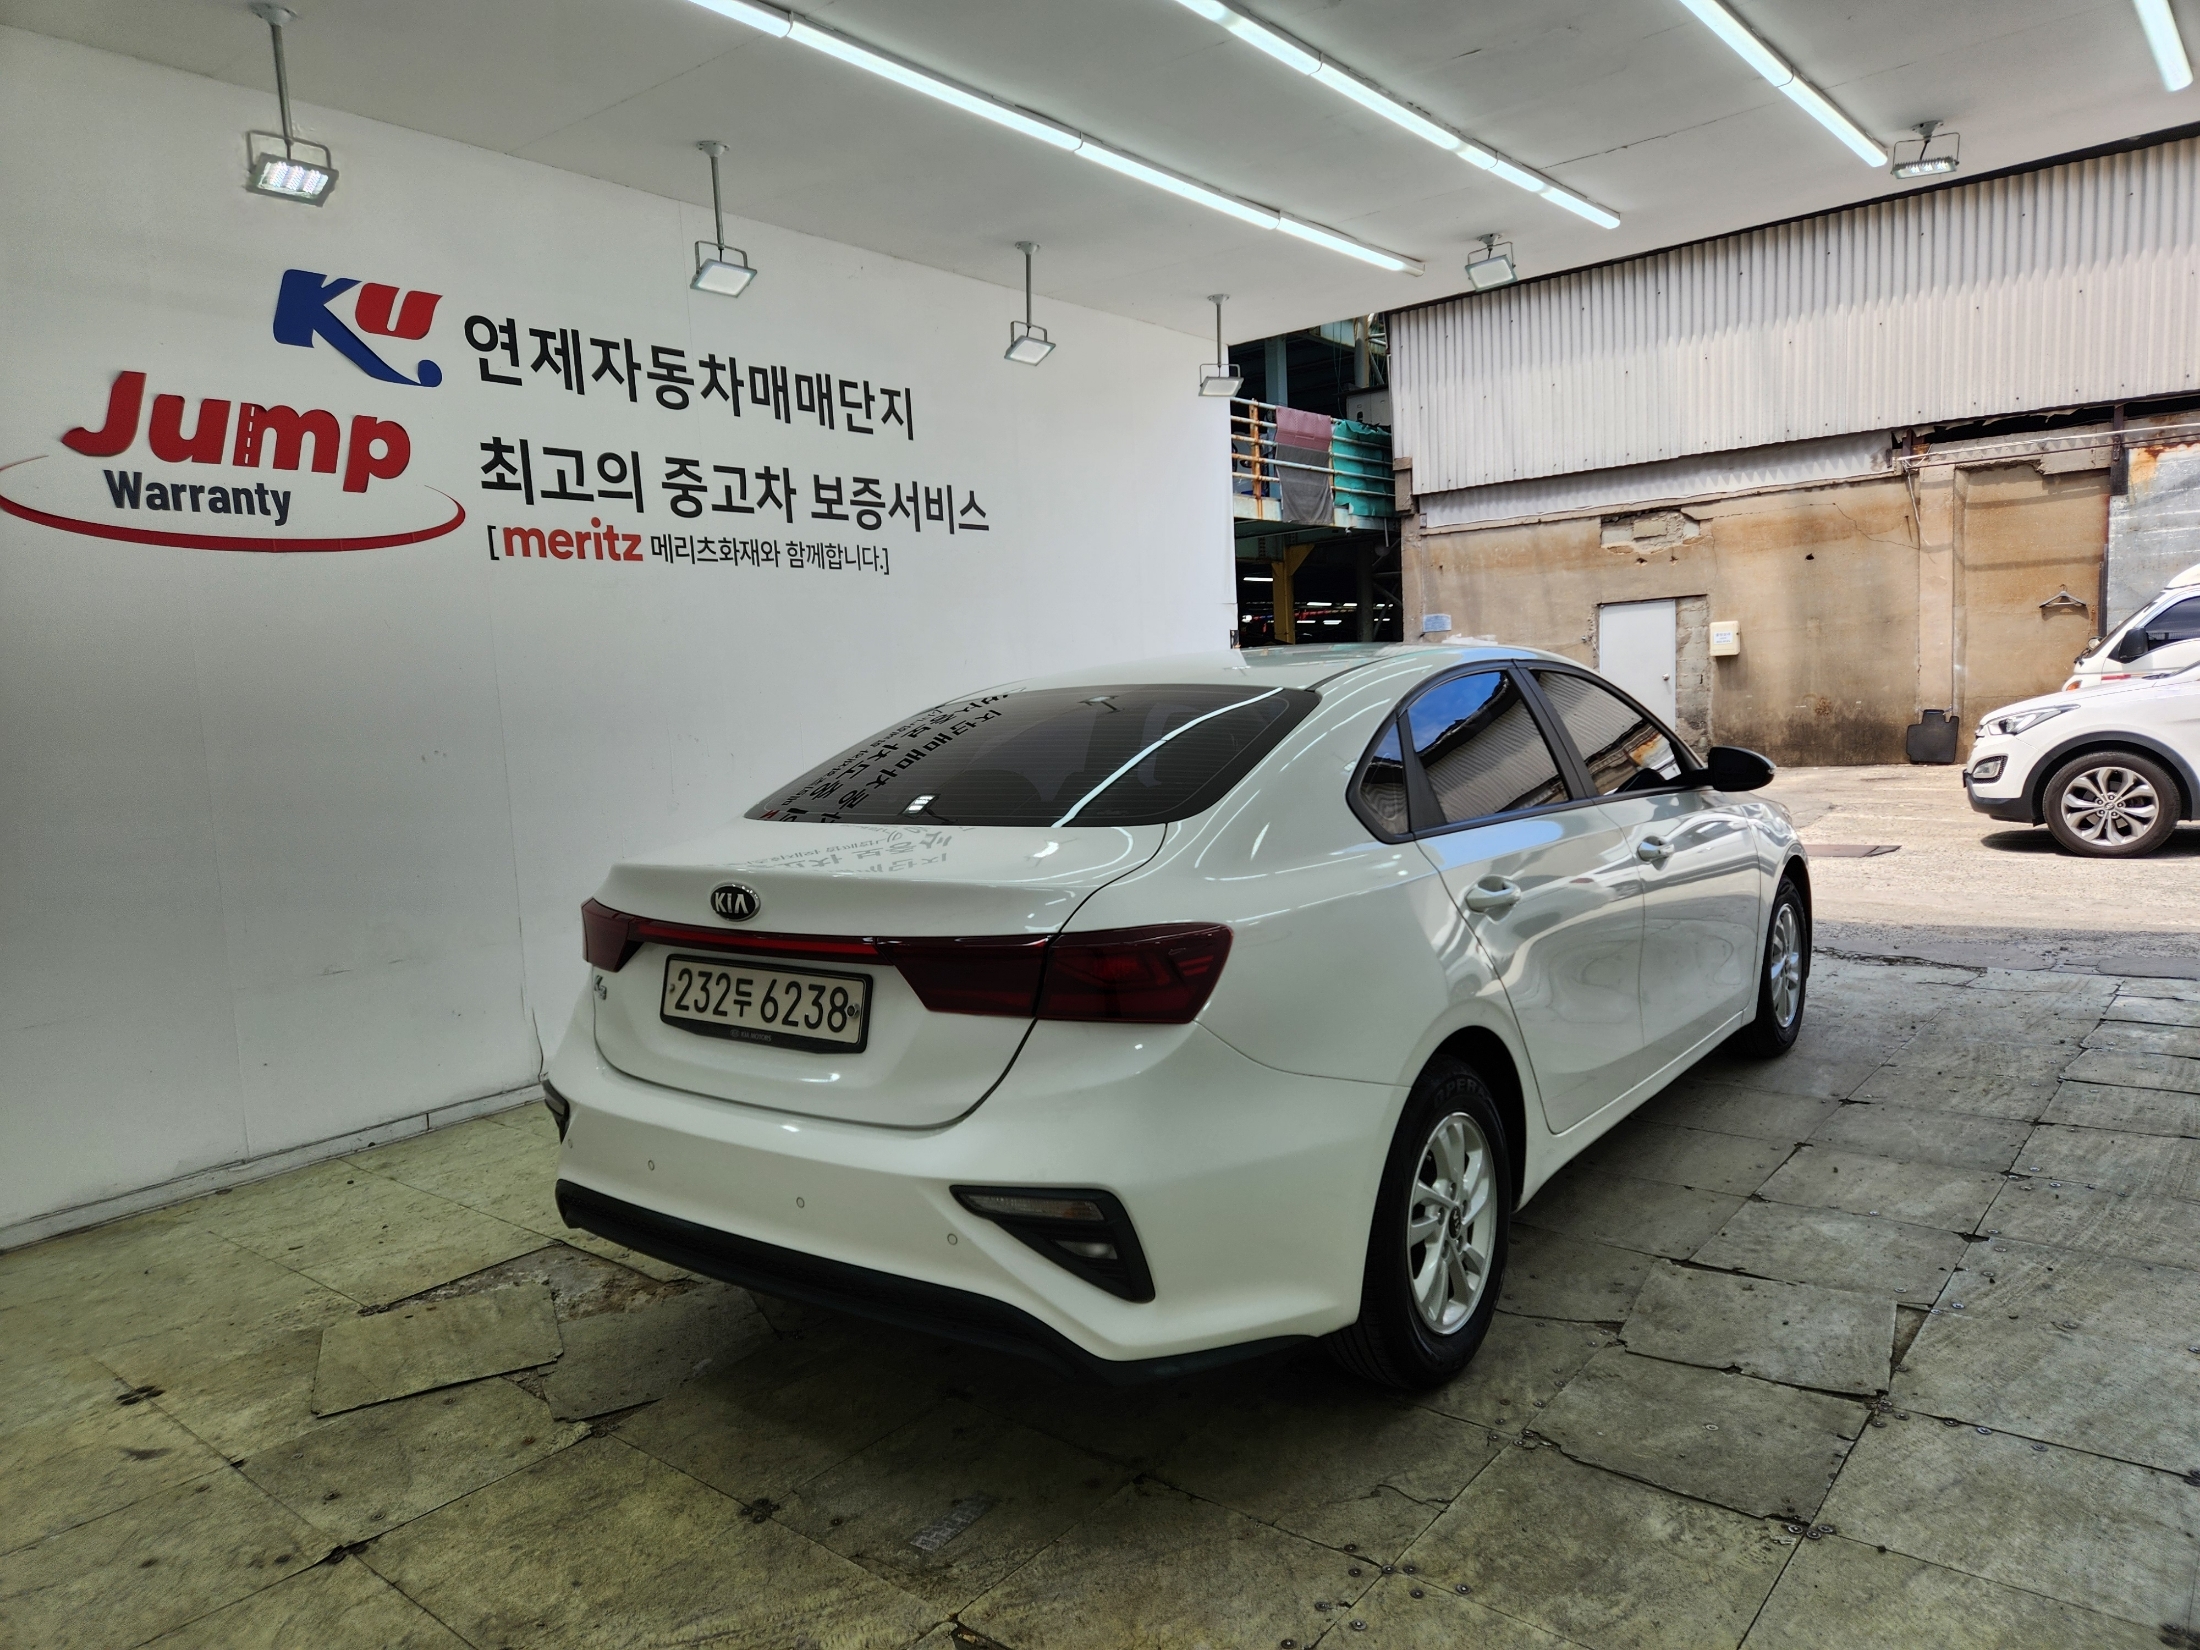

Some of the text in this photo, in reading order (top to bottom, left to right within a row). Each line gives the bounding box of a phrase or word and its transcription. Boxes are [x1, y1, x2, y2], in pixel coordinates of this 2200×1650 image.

[463, 314, 915, 441] 연제자동차매매단지
[61, 370, 411, 493] Jump
[103, 469, 291, 527] Warranty
[479, 436, 990, 535] 최고의 중고차 보증서비스
[650, 534, 781, 568] 메리츠화재와
[785, 541, 890, 575] 함께합니다.]
[715, 892, 749, 914] KIA
[760, 978, 849, 1033] 6238
